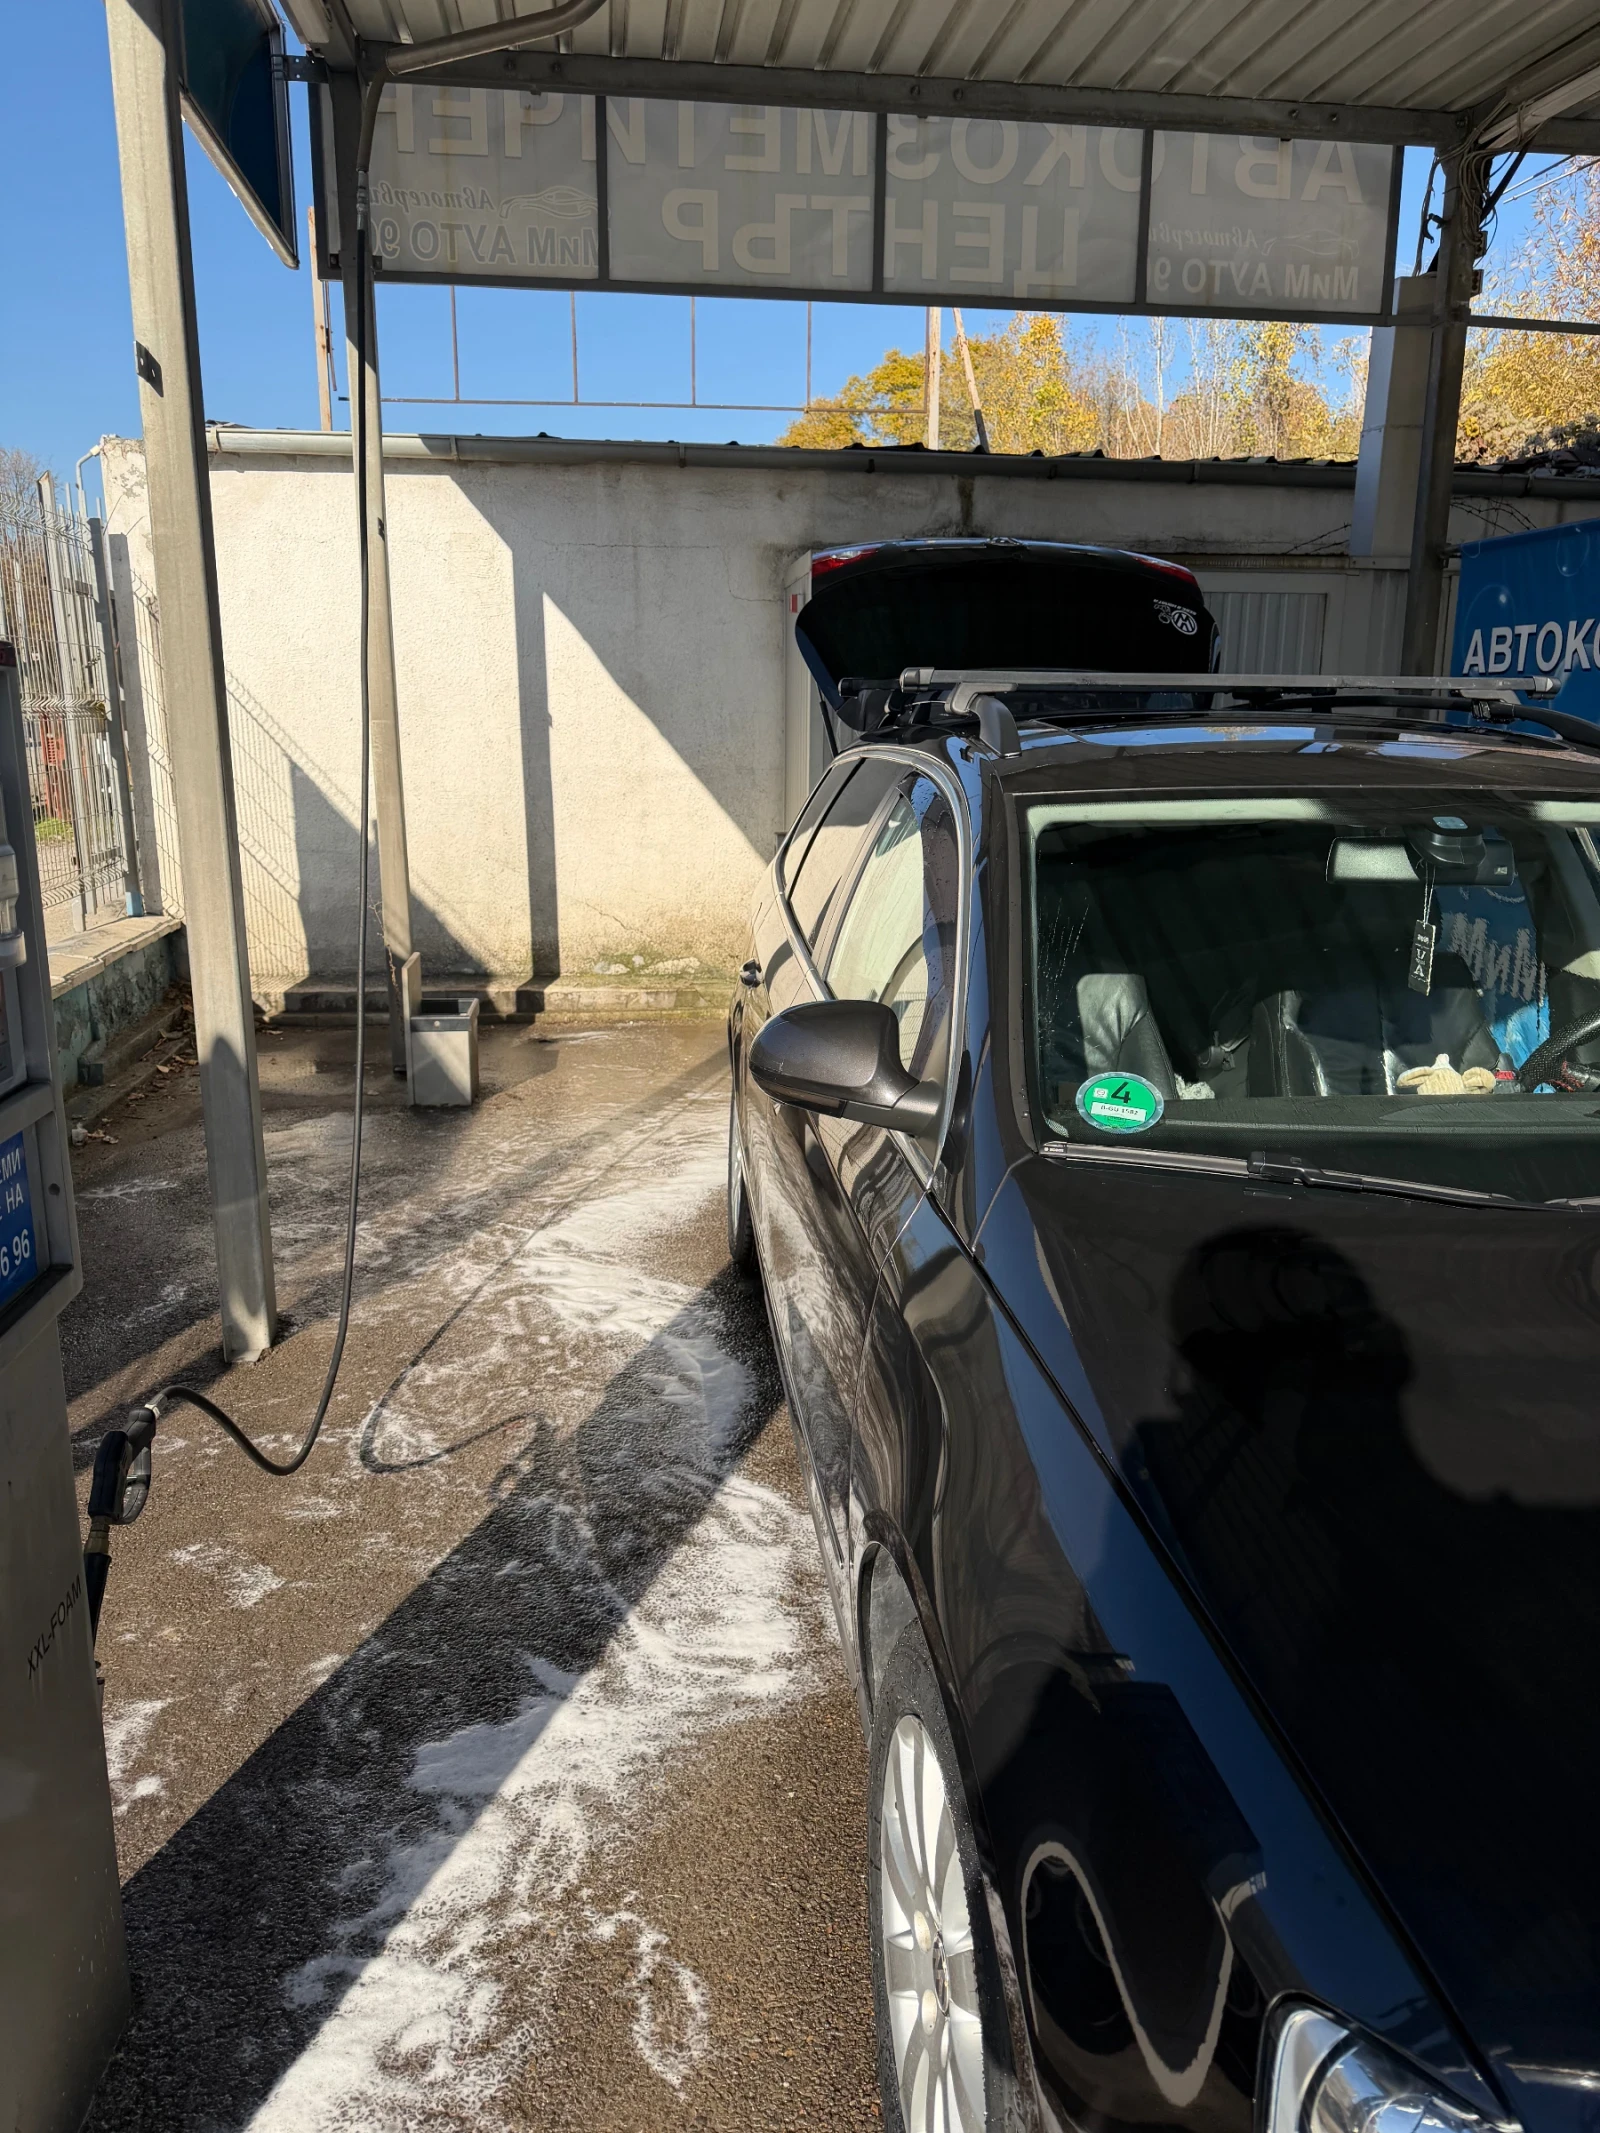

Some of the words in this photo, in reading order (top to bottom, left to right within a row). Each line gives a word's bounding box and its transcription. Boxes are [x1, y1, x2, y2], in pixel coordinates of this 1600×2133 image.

[1462, 618, 1600, 675] АВТОК
[1111, 1081, 1131, 1104] 4
[0, 1147, 21, 1184] МИ
[6, 1183, 24, 1214] НА
[13, 1228, 30, 1266] 96
[28, 1573, 82, 1680] XXL-FOAM
